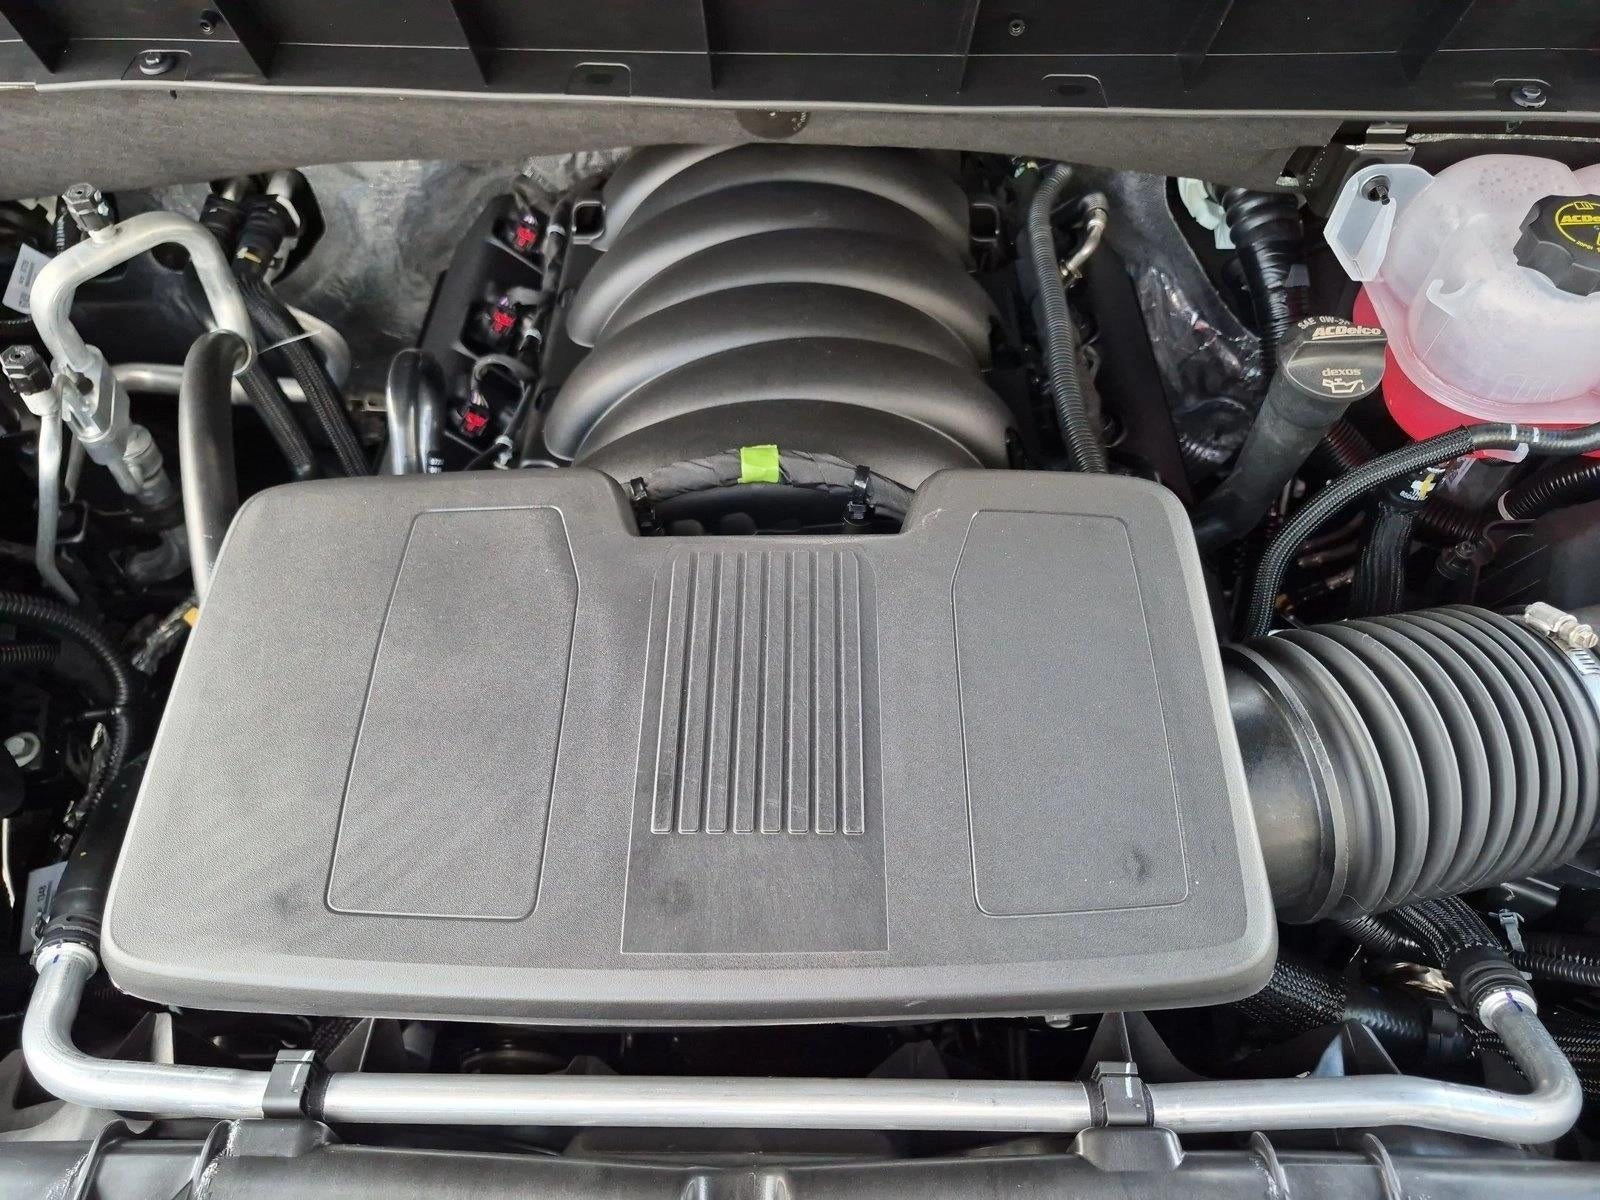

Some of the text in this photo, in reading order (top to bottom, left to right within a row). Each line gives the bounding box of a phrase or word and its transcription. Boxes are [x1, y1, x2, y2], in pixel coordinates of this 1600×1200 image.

[1297, 317, 1317, 330] SAE
[1311, 325, 1382, 338] ACDelco
[1322, 367, 1362, 377] dexos
